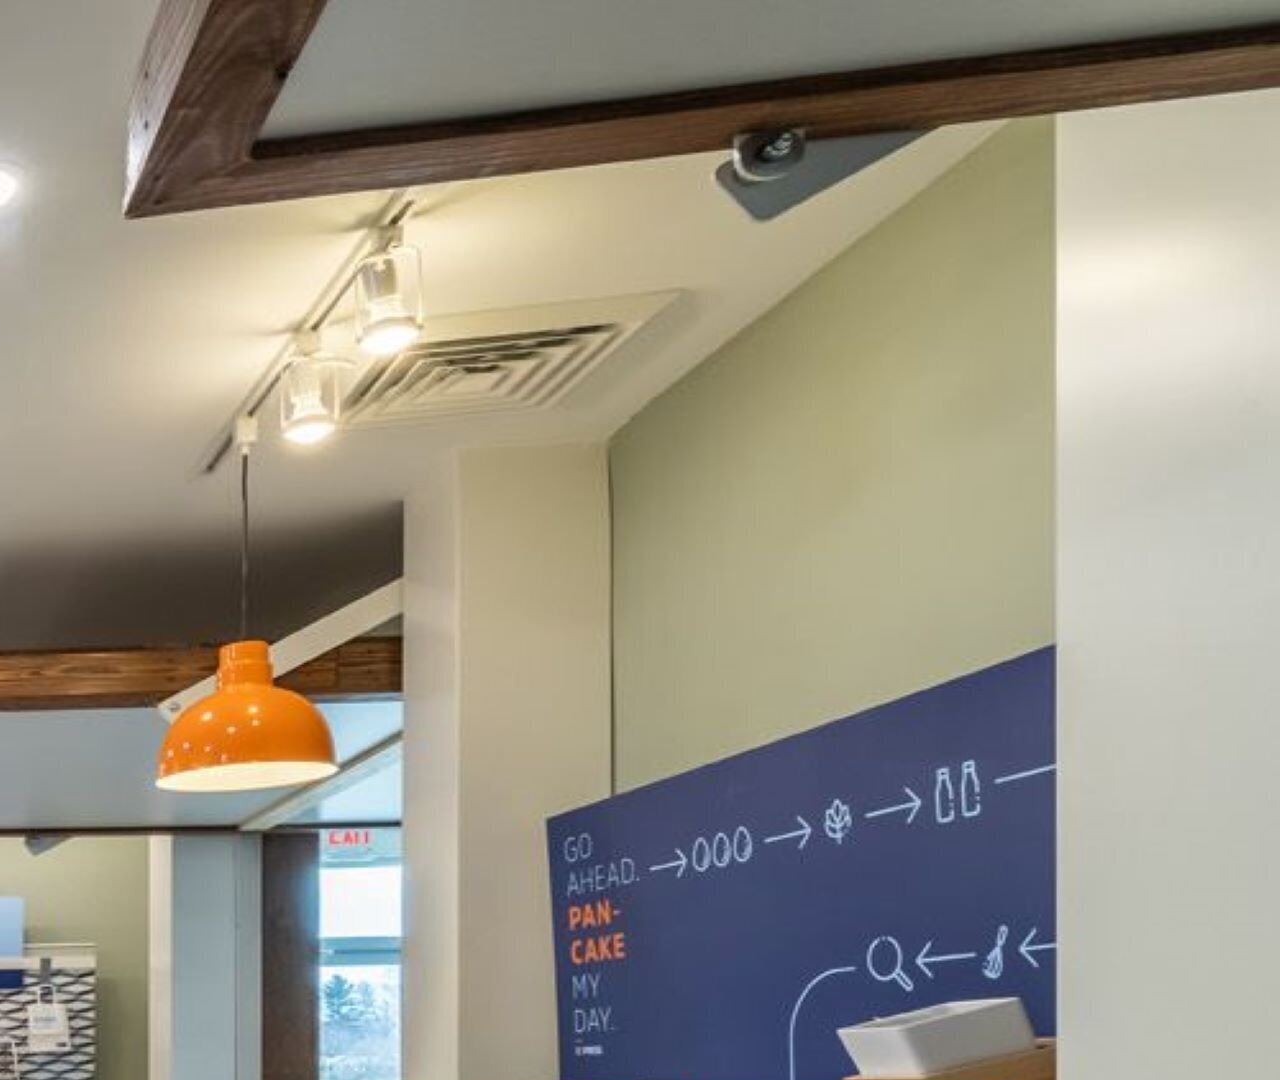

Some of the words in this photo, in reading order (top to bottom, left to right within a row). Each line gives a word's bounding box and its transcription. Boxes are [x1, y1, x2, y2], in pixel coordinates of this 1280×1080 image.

[564, 833, 593, 862] GO
[567, 858, 640, 897] AHEAD.
[569, 899, 622, 931] PAN-
[571, 932, 626, 964] CAKE
[572, 973, 600, 999] MY
[574, 1006, 616, 1033] DAY.
